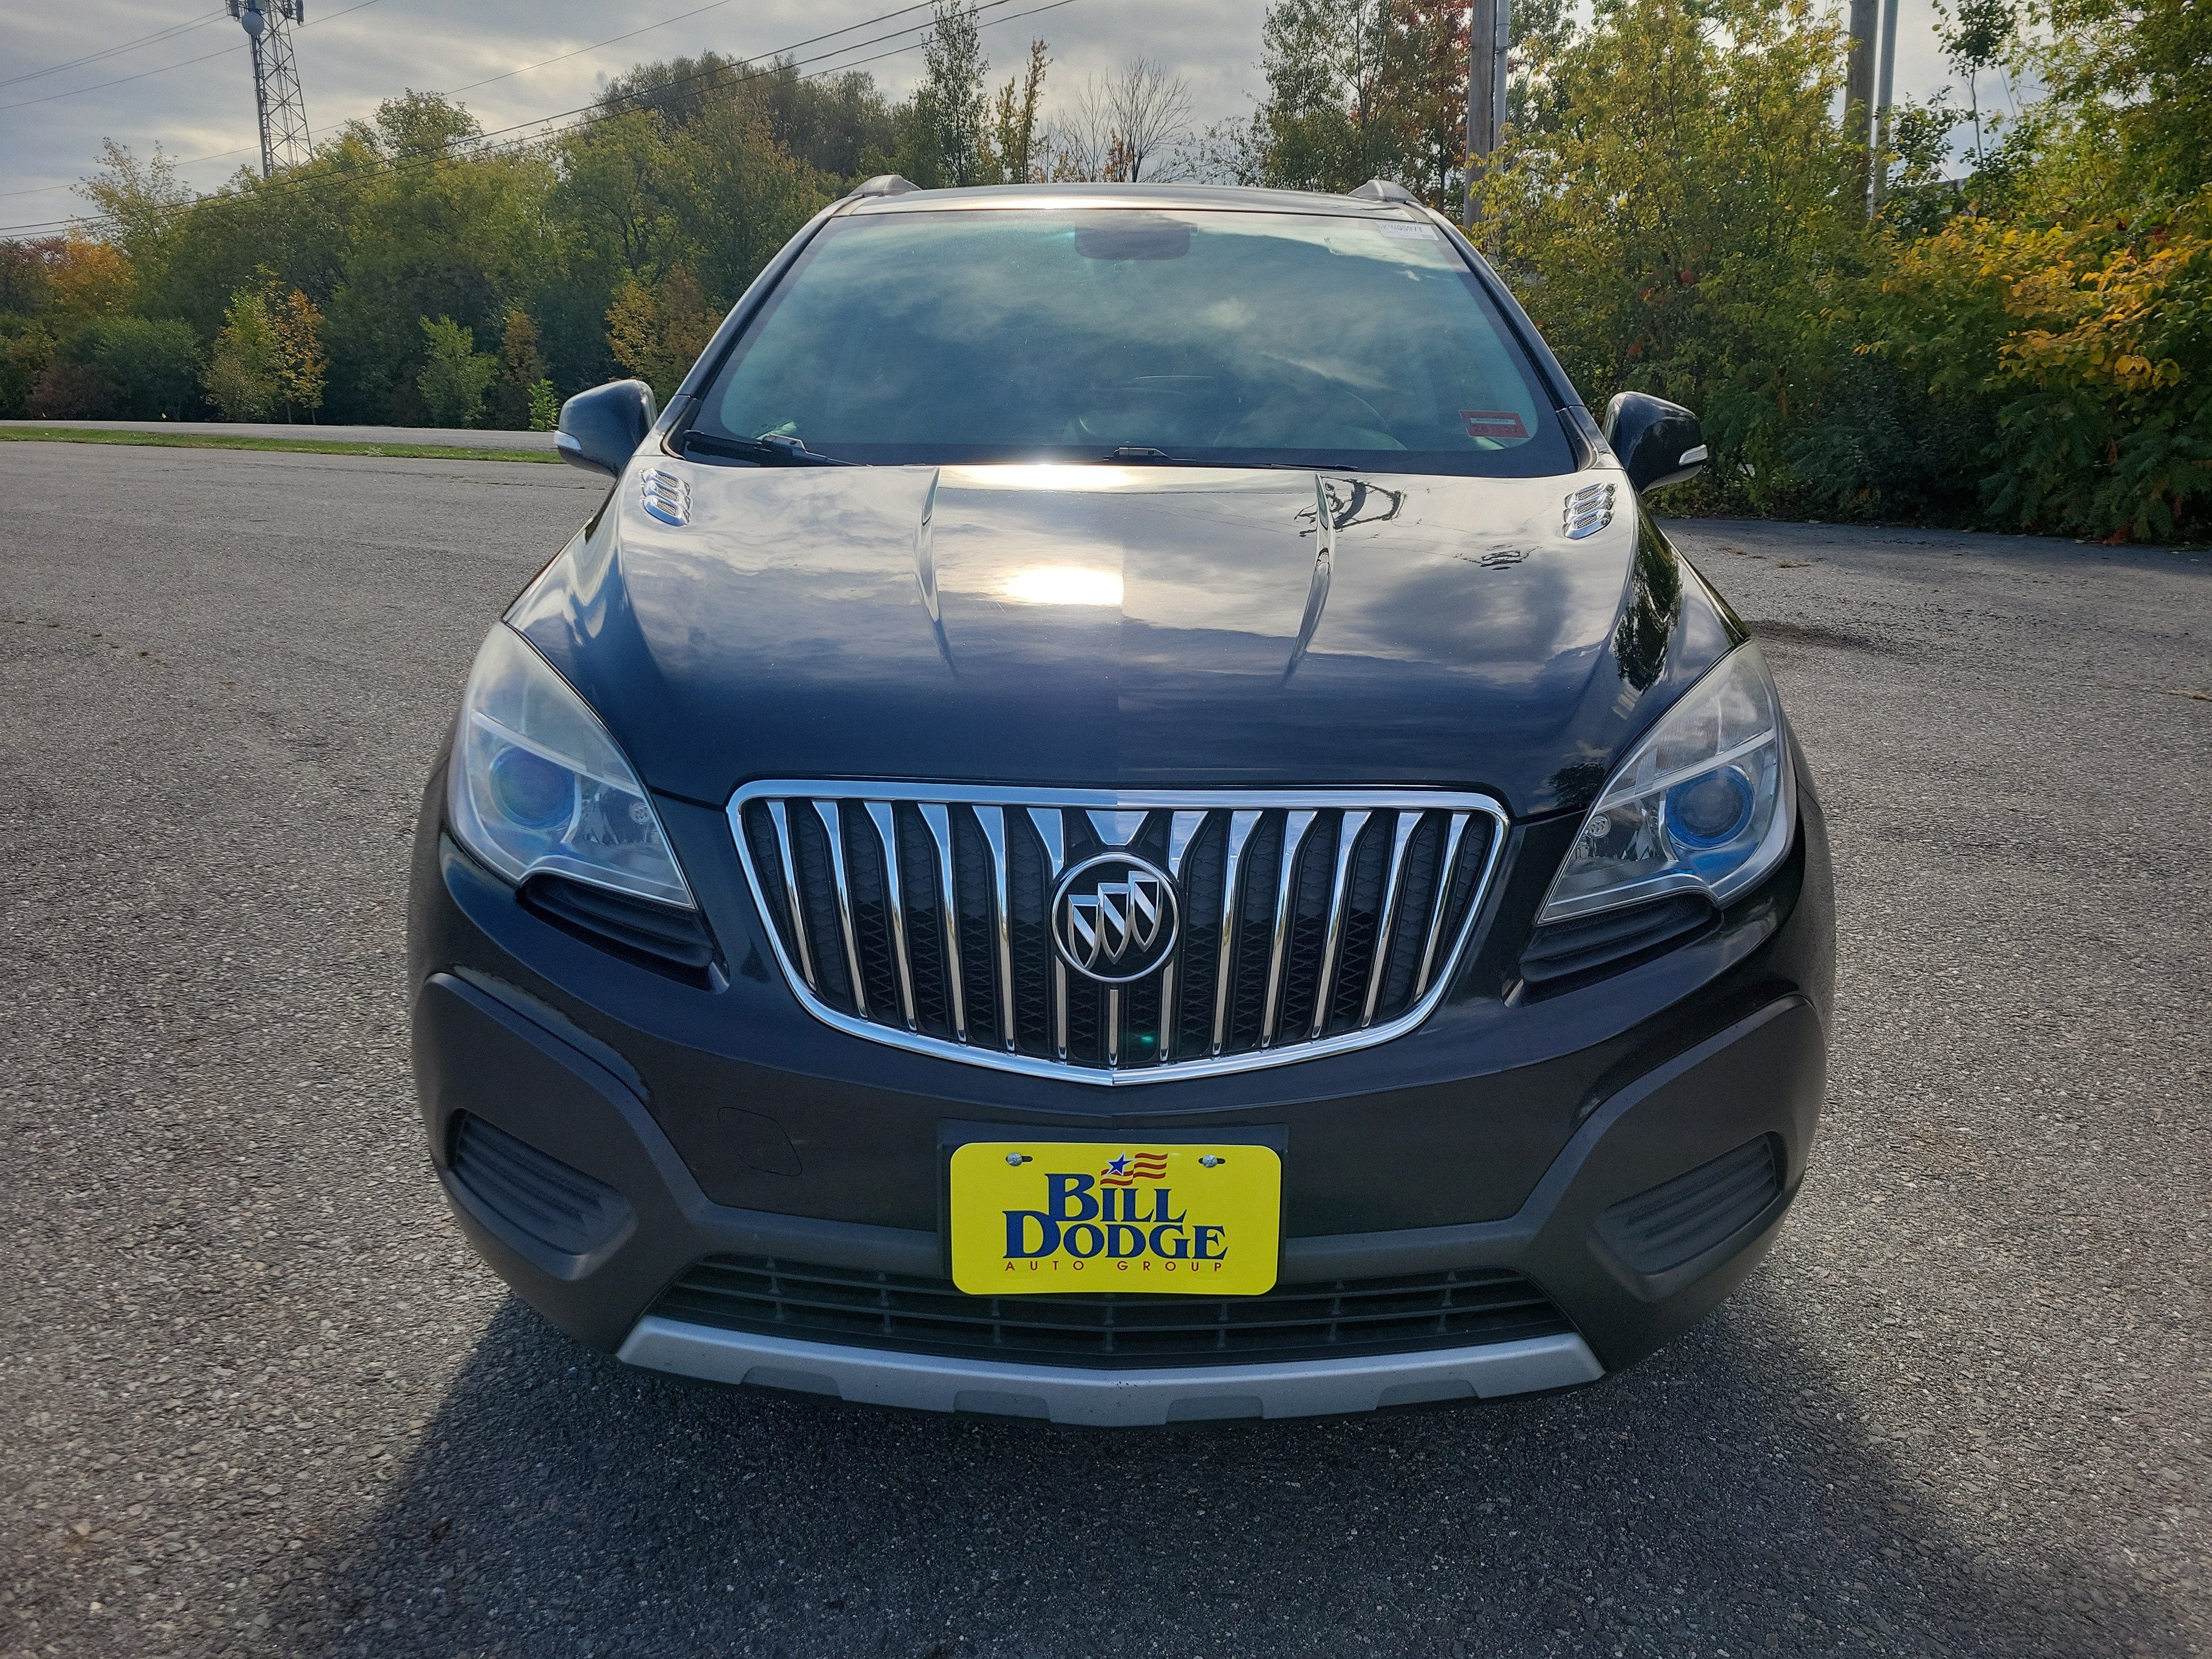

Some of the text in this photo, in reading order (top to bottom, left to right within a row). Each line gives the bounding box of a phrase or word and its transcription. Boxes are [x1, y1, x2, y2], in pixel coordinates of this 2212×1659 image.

[1045, 1173, 1187, 1222] BILL
[1003, 1210, 1228, 1259] DODGE
[1005, 1261, 1222, 1272] AUTO GROUP
